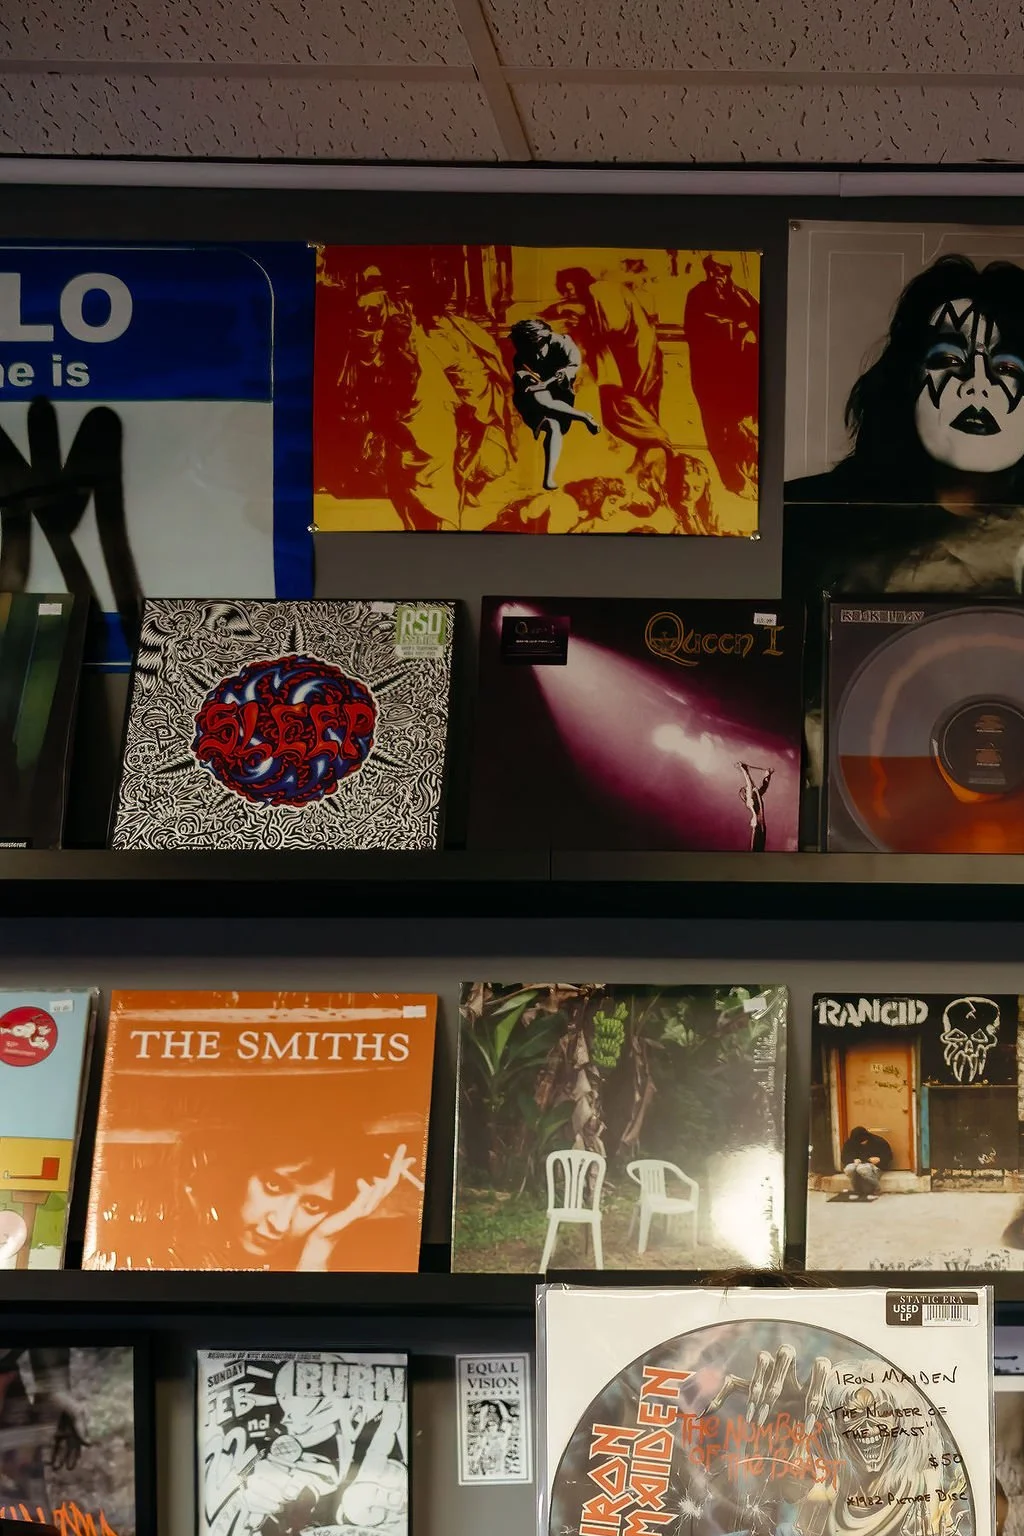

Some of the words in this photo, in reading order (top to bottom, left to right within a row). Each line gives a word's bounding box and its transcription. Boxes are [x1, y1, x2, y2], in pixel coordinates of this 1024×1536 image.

[53, 353, 90, 387] is
[401, 609, 442, 637] RSD
[645, 611, 756, 667] Queen
[761, 625, 785, 656] I
[199, 701, 375, 762] SLEEP
[817, 997, 929, 1028] RANCID
[130, 1030, 221, 1060] THE
[237, 1030, 411, 1062] SMITHS
[893, 1304, 919, 1314] USED
[900, 1295, 939, 1304] STATIC
[943, 1295, 964, 1304] ERA
[900, 1313, 912, 1322] LP
[207, 1364, 245, 1388] SUNDAY
[467, 1361, 519, 1376] EQUAL
[835, 1370, 875, 1385] IRON
[882, 1365, 958, 1386] MAIDEN
[294, 1361, 406, 1402] BURN
[467, 1378, 519, 1390] VISION
[206, 1382, 257, 1426] FEB
[866, 1402, 923, 1418] NUMBER
[842, 1427, 869, 1439] THE
[929, 1453, 964, 1469] $50
[934, 1489, 969, 1502] DISC
